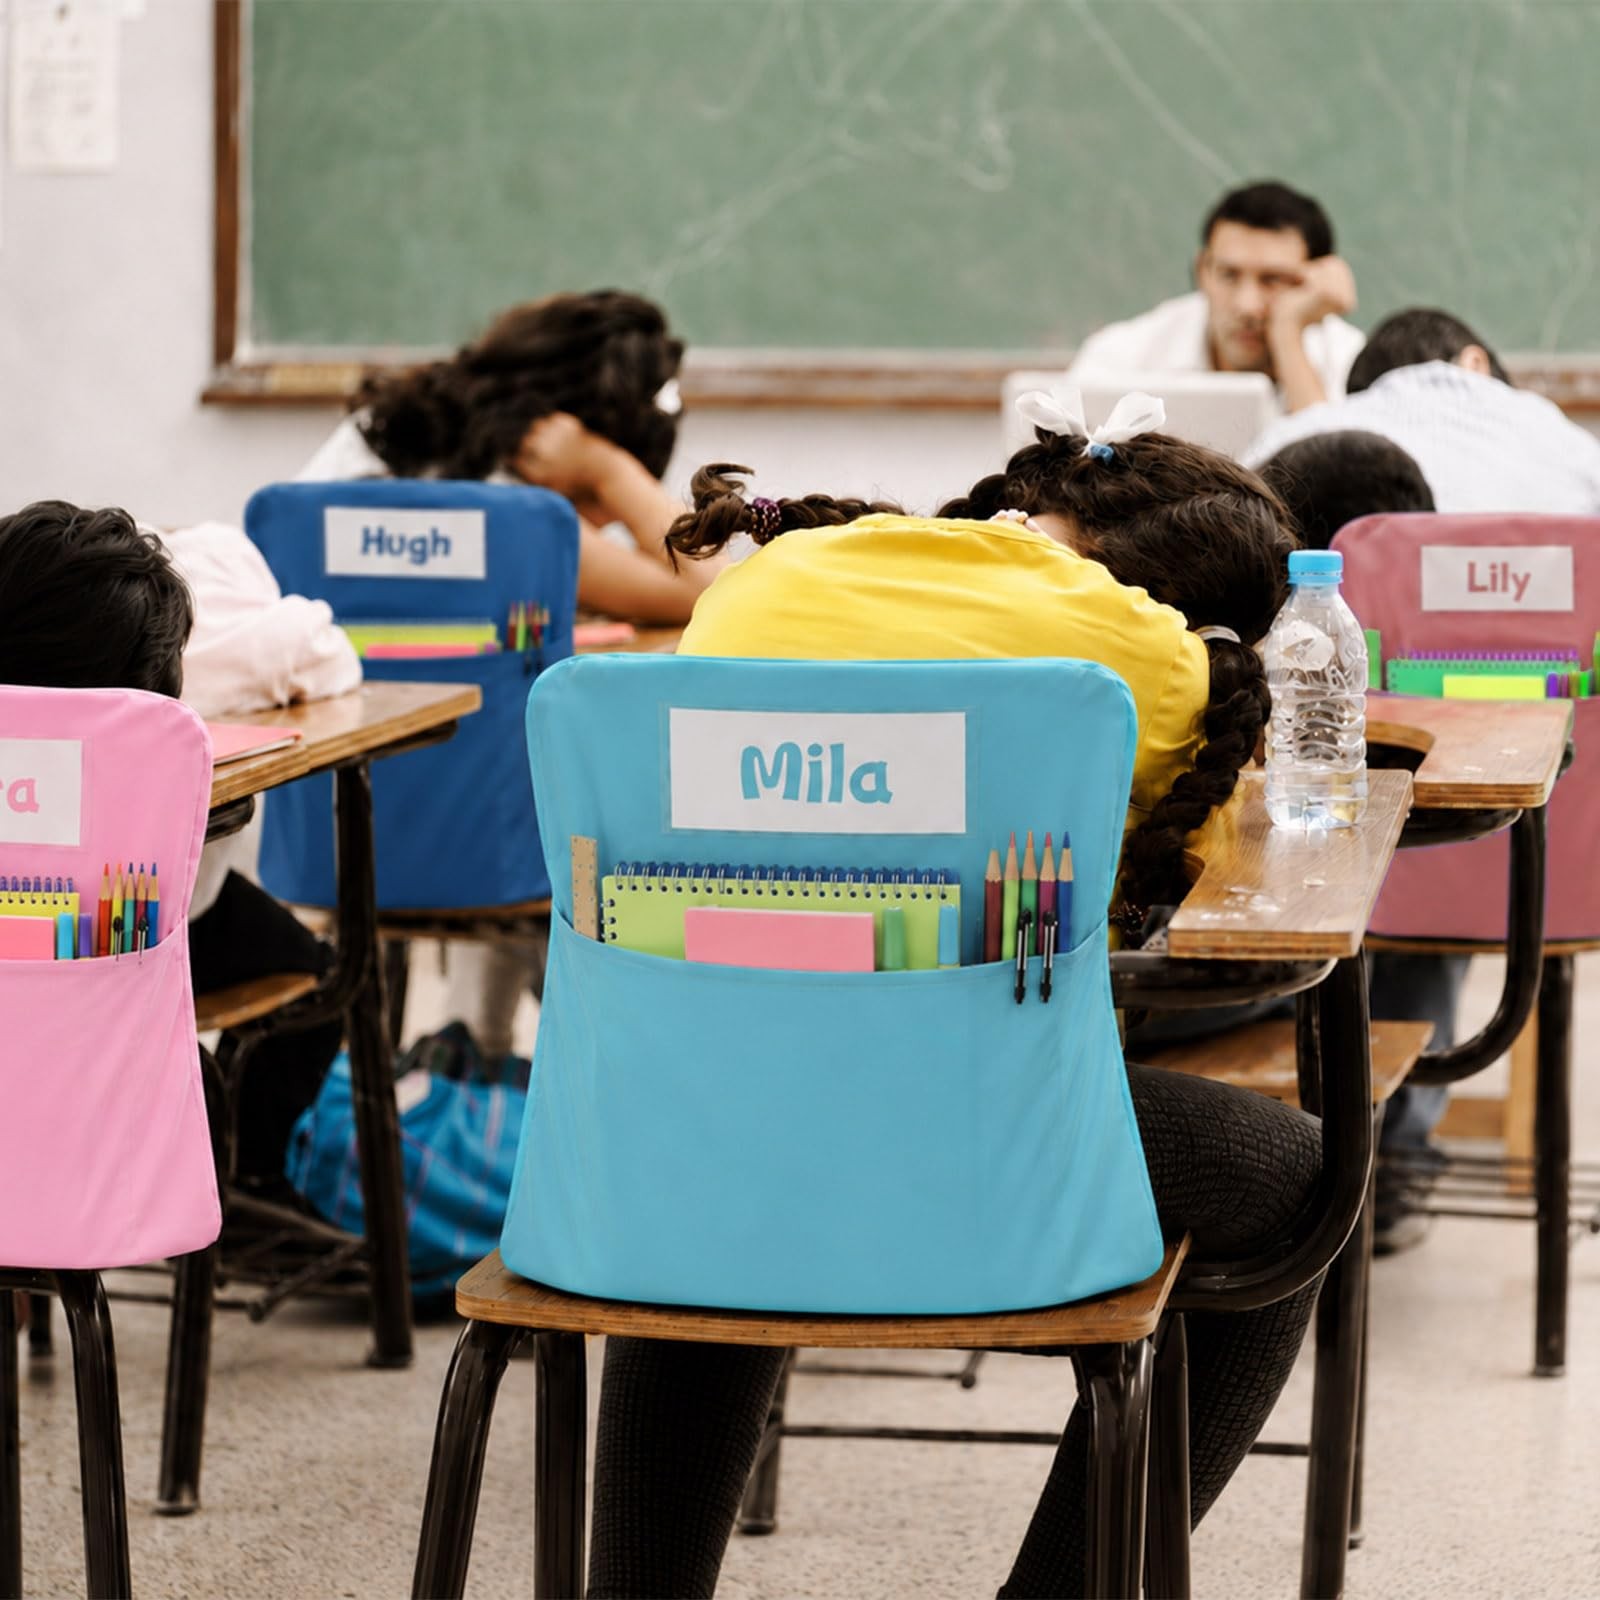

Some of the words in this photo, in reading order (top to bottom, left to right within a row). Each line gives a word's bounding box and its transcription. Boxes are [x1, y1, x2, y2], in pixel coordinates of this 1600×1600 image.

[361, 525, 452, 566] Hugh
[1467, 561, 1532, 602] Lily
[740, 742, 892, 804] Mila
[0, 777, 41, 814] a
